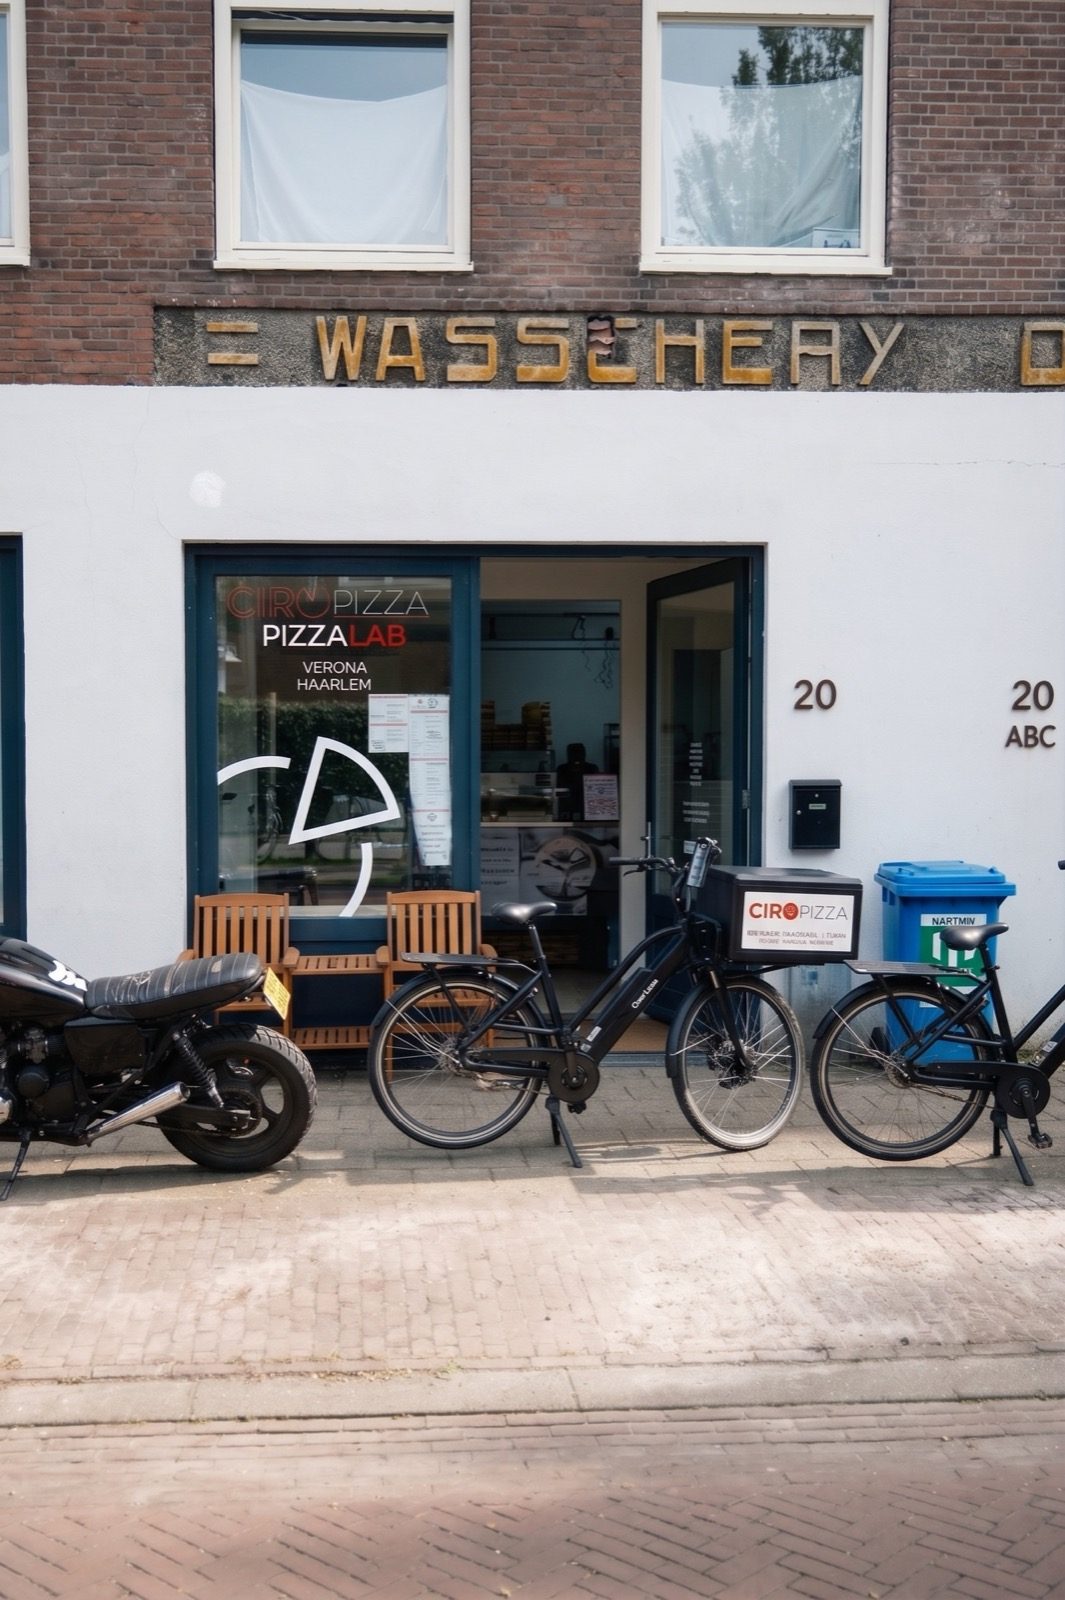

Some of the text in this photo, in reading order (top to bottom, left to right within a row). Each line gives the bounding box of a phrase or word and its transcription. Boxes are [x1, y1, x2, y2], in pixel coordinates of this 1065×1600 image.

[302, 661, 368, 675] VERONA
[296, 678, 372, 692] HAARLEM
[793, 679, 837, 710] 20
[1011, 680, 1055, 711] 20
[1004, 725, 1057, 749] ABC
